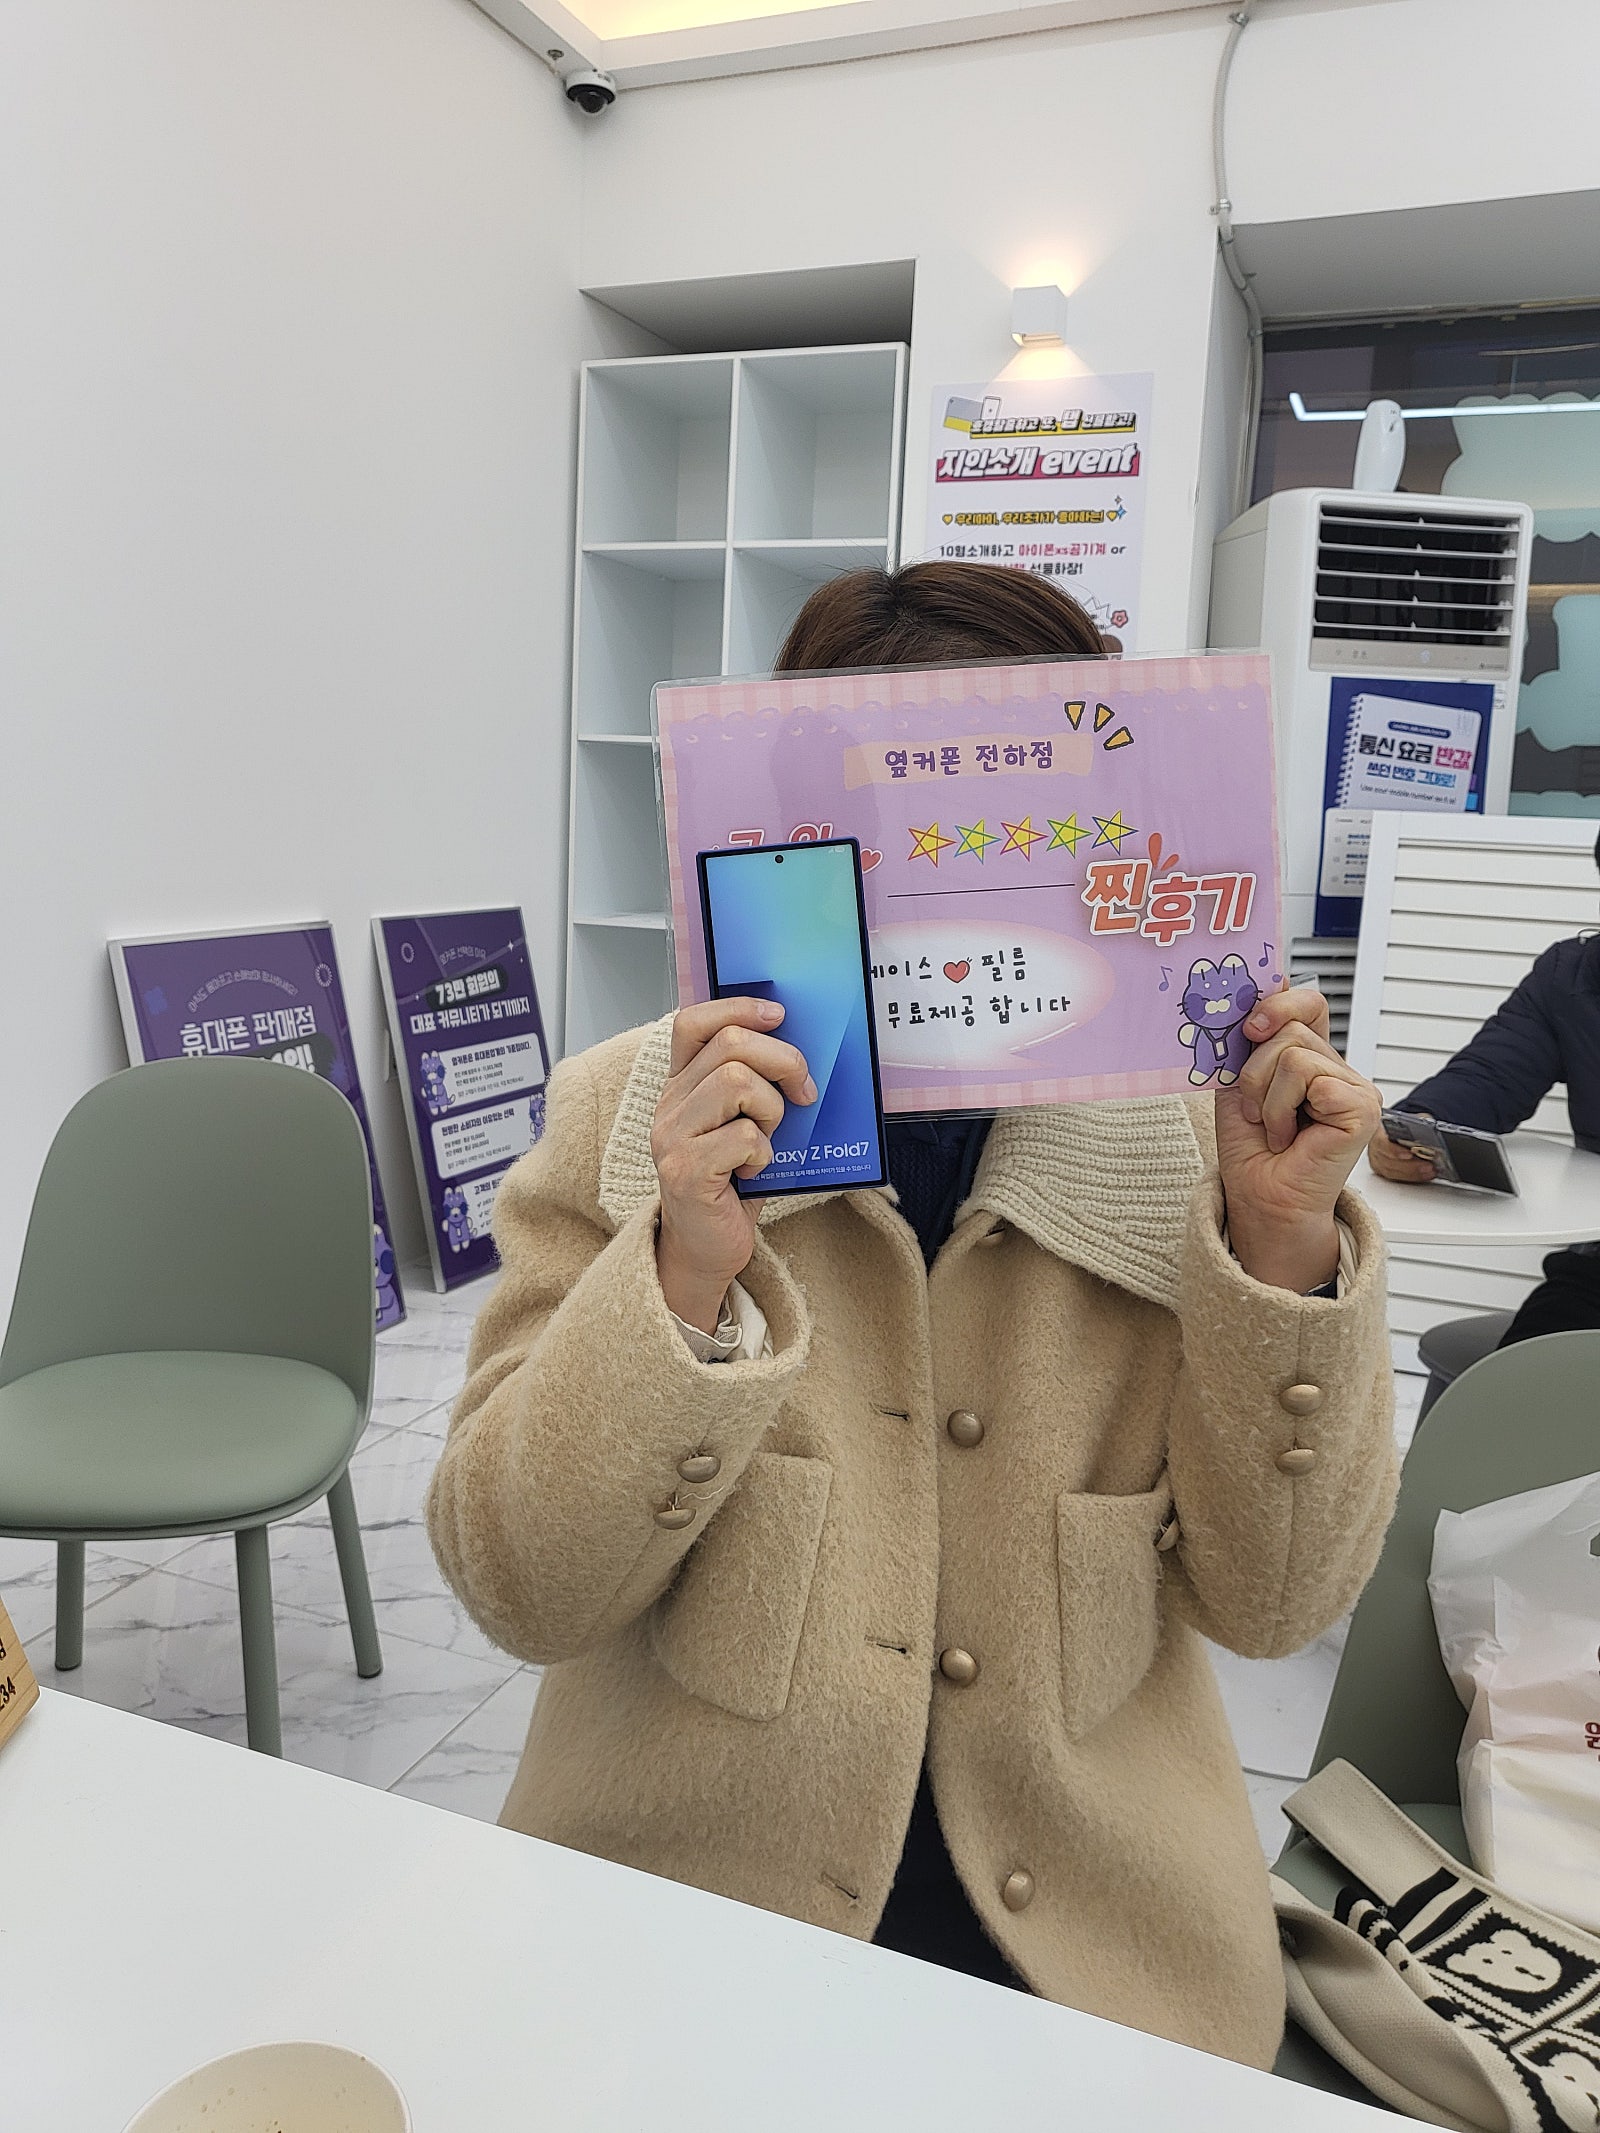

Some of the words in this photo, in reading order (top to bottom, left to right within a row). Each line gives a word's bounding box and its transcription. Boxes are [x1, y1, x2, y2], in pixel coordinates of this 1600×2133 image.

[938, 446, 1040, 478] 지인소개
[1041, 442, 1138, 476] event
[1111, 545, 1126, 555] or
[884, 747, 962, 778] 옆커폰
[975, 741, 1055, 772] 전하점
[1359, 734, 1396, 758] 통신
[1397, 740, 1434, 764] 요금
[1083, 859, 1256, 946] 찐후기
[981, 947, 1026, 982] 필름
[435, 979, 467, 1006] 73만
[467, 968, 500, 999] 회원의
[410, 1010, 437, 1035] 대표
[437, 1002, 491, 1030] 커뮤니티가
[491, 996, 531, 1023] 되기까지
[888, 995, 976, 1029] 무료제공
[989, 994, 1071, 1025] 합니다
[180, 1016, 251, 1057] 휴대폰
[252, 1005, 318, 1045] 판매점
[810, 1145, 821, 1161] Z
[824, 1141, 869, 1159] Fold7
